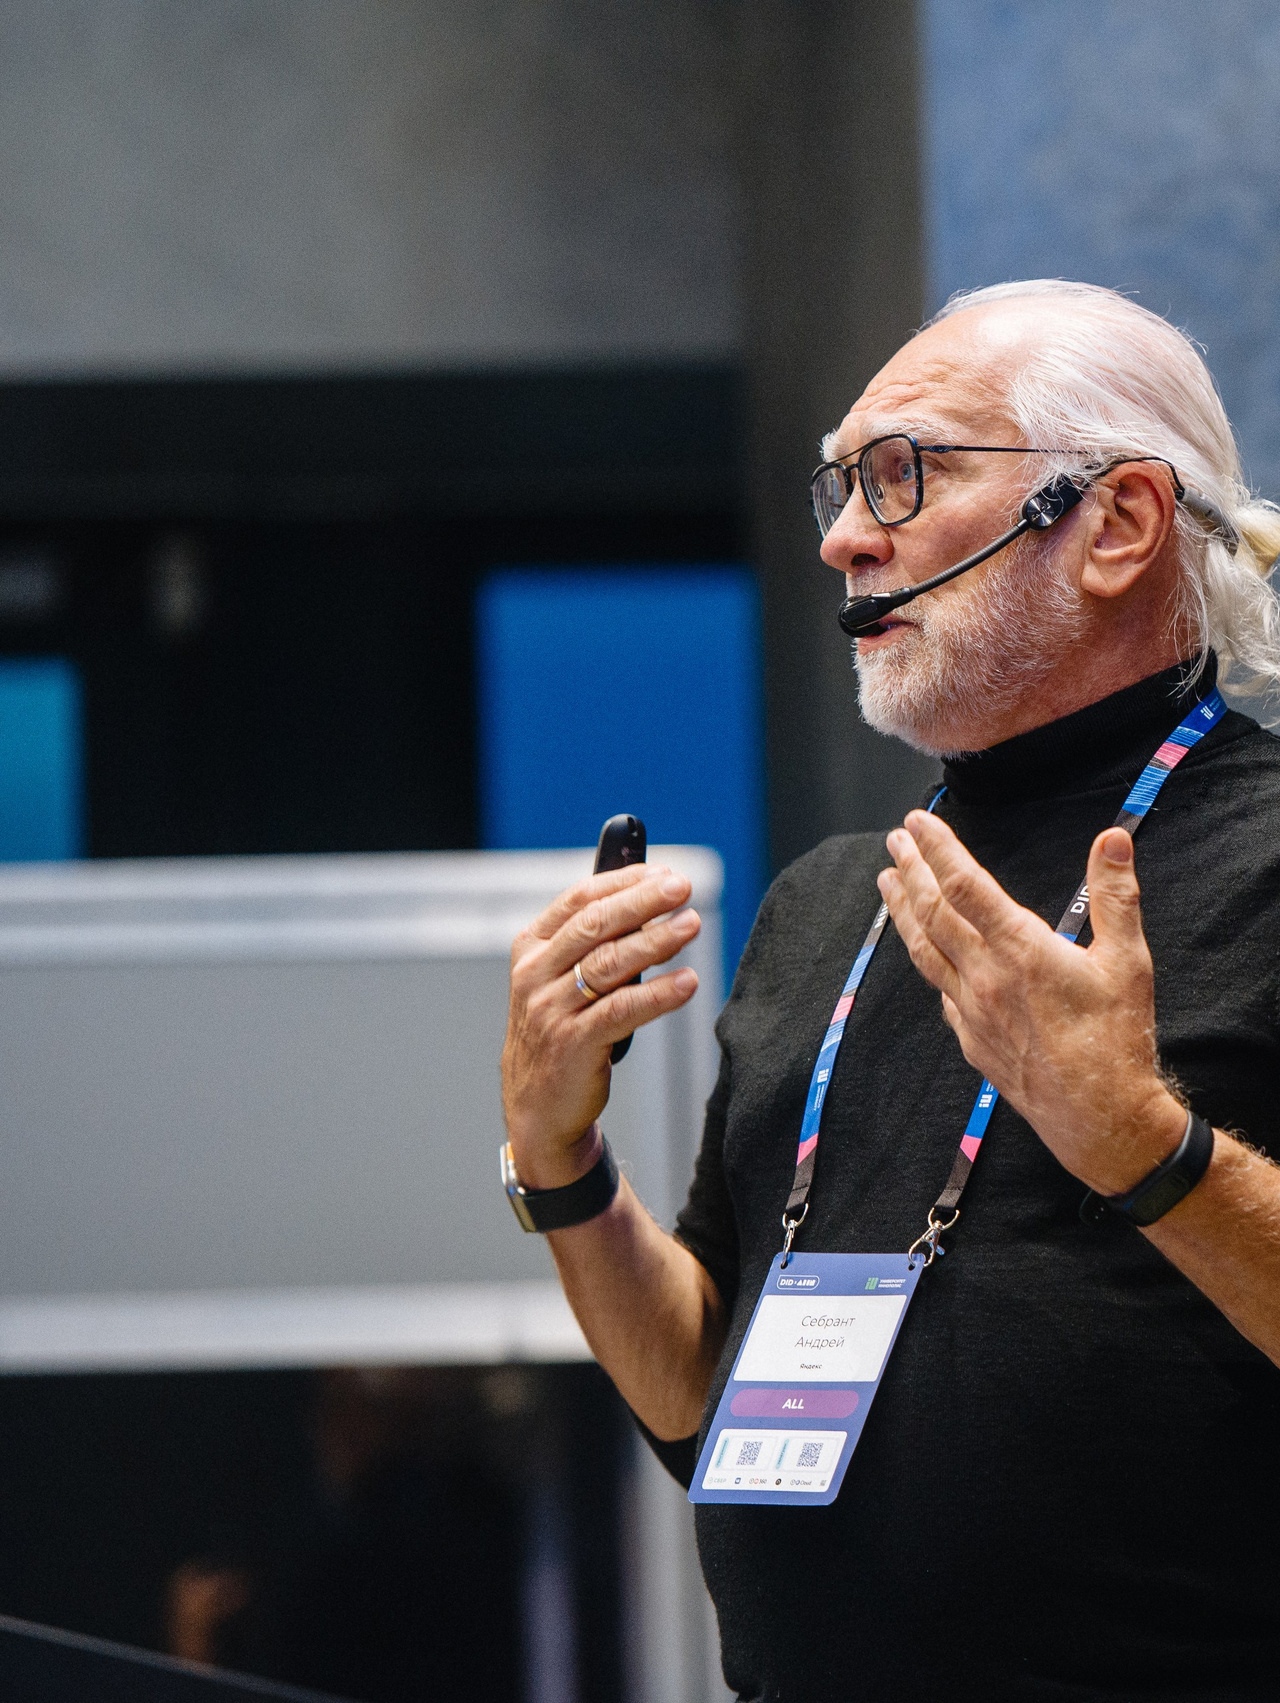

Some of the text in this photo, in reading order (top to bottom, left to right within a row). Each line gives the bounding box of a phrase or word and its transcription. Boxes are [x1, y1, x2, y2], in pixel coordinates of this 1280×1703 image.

[801, 1314, 856, 1329] Себрант
[794, 1336, 846, 1350] Андрей
[781, 1398, 805, 1410] ALL
